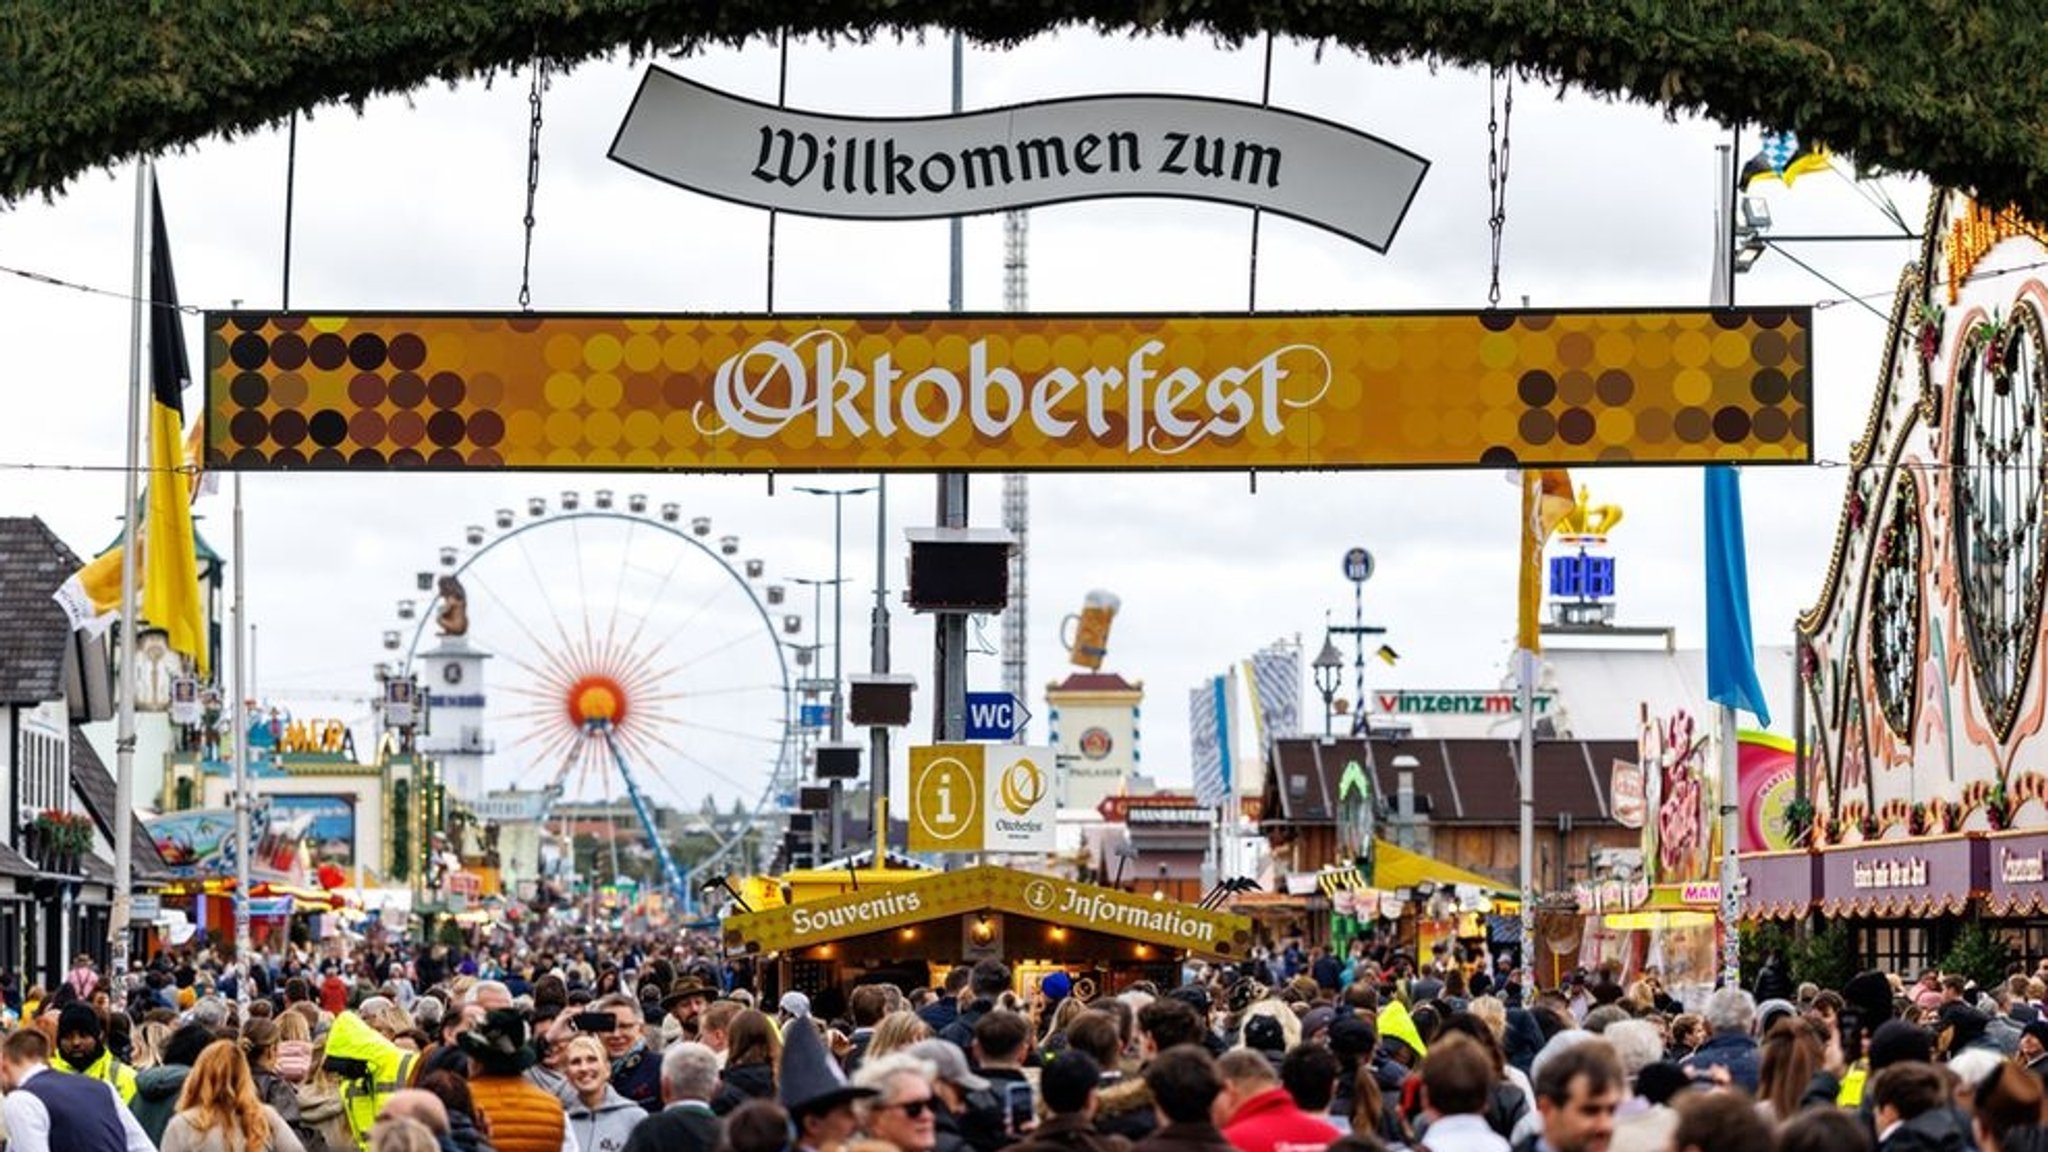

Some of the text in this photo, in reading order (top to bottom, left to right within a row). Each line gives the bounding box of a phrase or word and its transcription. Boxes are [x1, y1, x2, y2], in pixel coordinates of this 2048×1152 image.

[751, 124, 1284, 195] Willkommen zum
[692, 328, 1332, 454] Oktoberfest
[970, 703, 1011, 729] WC
[792, 890, 922, 935] Souvenirs
[1060, 887, 1214, 942] Information
